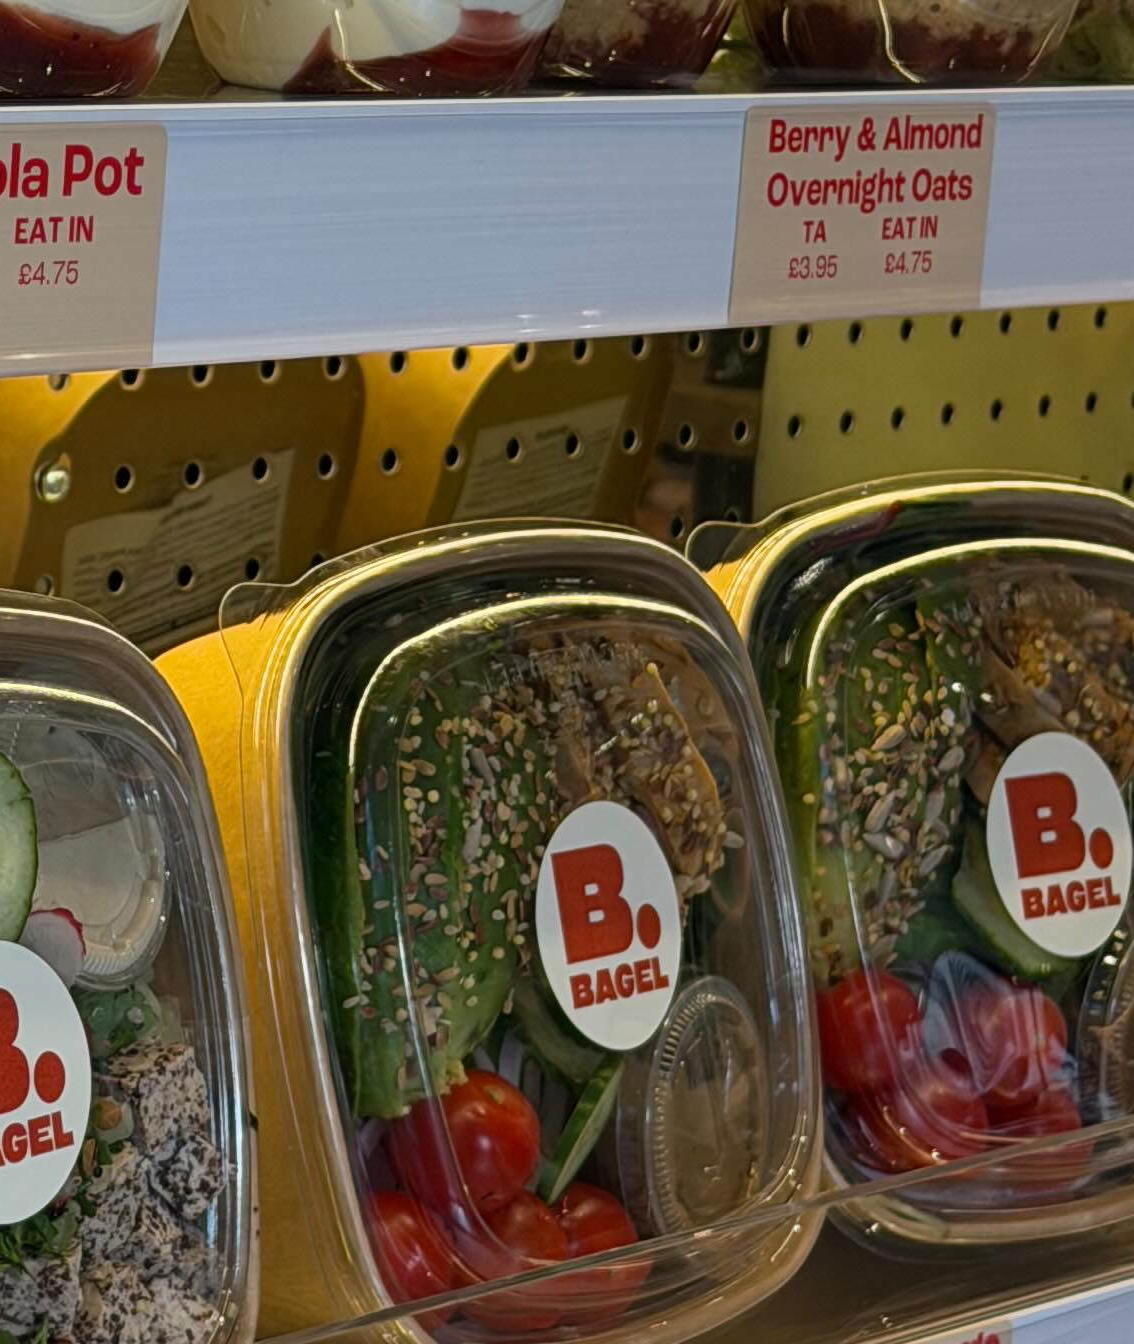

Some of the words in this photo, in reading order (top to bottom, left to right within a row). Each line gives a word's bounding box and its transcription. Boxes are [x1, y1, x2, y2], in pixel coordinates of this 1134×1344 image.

[768, 118, 851, 162] Berry
[857, 116, 876, 152] &
[883, 113, 984, 151] Almond
[62, 144, 144, 197] Pot
[767, 168, 906, 214] Overnight
[912, 168, 972, 202] Oats
[14, 217, 63, 245] EAT
[68, 215, 94, 243] IN
[803, 220, 827, 244] TA
[881, 217, 917, 240] EAT
[919, 216, 938, 238] IN
[18, 260, 79, 286] £4.75
[788, 255, 838, 280] £3.95
[884, 250, 932, 274] £4.75
[1004, 771, 1114, 880] B.
[550, 843, 661, 965] B.
[1021, 876, 1121, 920] BAGEL
[569, 956, 669, 1009] BAGEL
